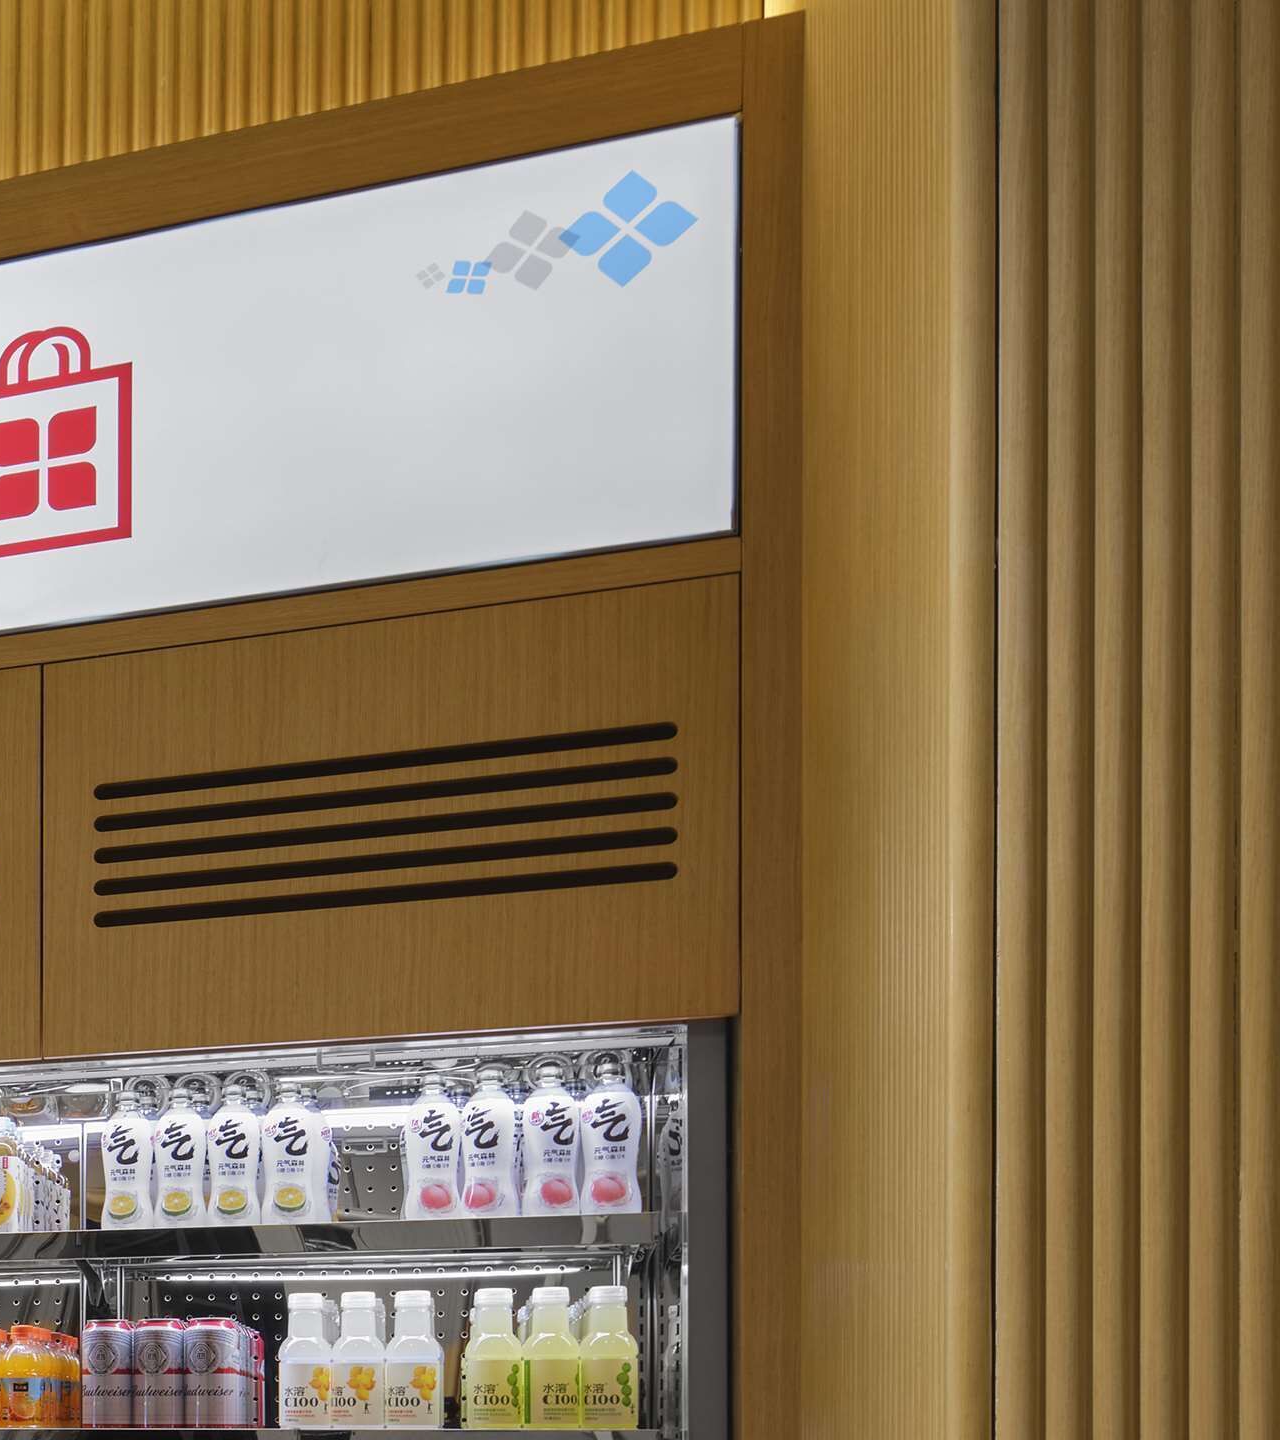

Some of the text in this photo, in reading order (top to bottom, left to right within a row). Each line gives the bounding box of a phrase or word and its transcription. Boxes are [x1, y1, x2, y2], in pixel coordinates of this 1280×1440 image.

[540, 1101, 576, 1146] 气
[590, 1098, 630, 1142] 气
[418, 1109, 454, 1152] 气
[464, 1106, 499, 1149] 气
[160, 1121, 195, 1161] 气
[215, 1119, 250, 1159] 气
[273, 1116, 308, 1156] 气
[107, 1124, 140, 1166] 气
[593, 1145, 626, 1154] 元气森林
[467, 1152, 496, 1161] 元气森林
[543, 1149, 572, 1157] 元气森林
[276, 1159, 305, 1167] 元气森林
[422, 1155, 450, 1163] 元气森林
[218, 1162, 246, 1170] 元气森林
[110, 1168, 137, 1176] 元气森林
[284, 1386, 306, 1397] 水溶
[473, 1383, 497, 1395] 水溶
[542, 1383, 568, 1394] 水溶
[284, 1397, 319, 1408] C100
[473, 1395, 511, 1405] C100
[542, 1395, 578, 1405] C100
